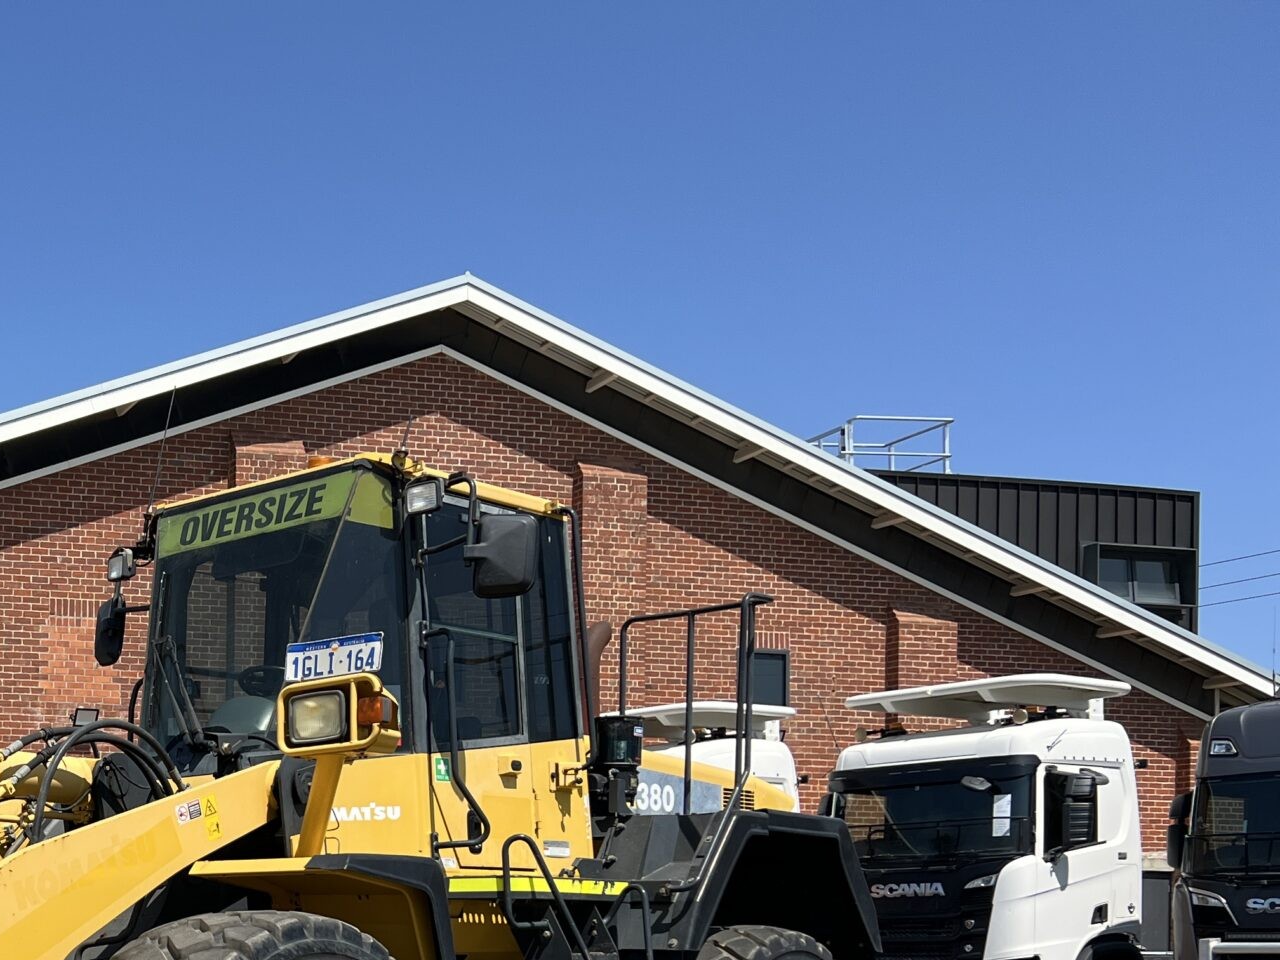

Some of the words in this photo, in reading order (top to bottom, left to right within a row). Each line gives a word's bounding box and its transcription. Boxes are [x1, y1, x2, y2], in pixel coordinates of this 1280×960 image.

[179, 483, 327, 546] OVERSIZE
[636, 782, 675, 812] 380
[870, 882, 946, 898] SCANIA
